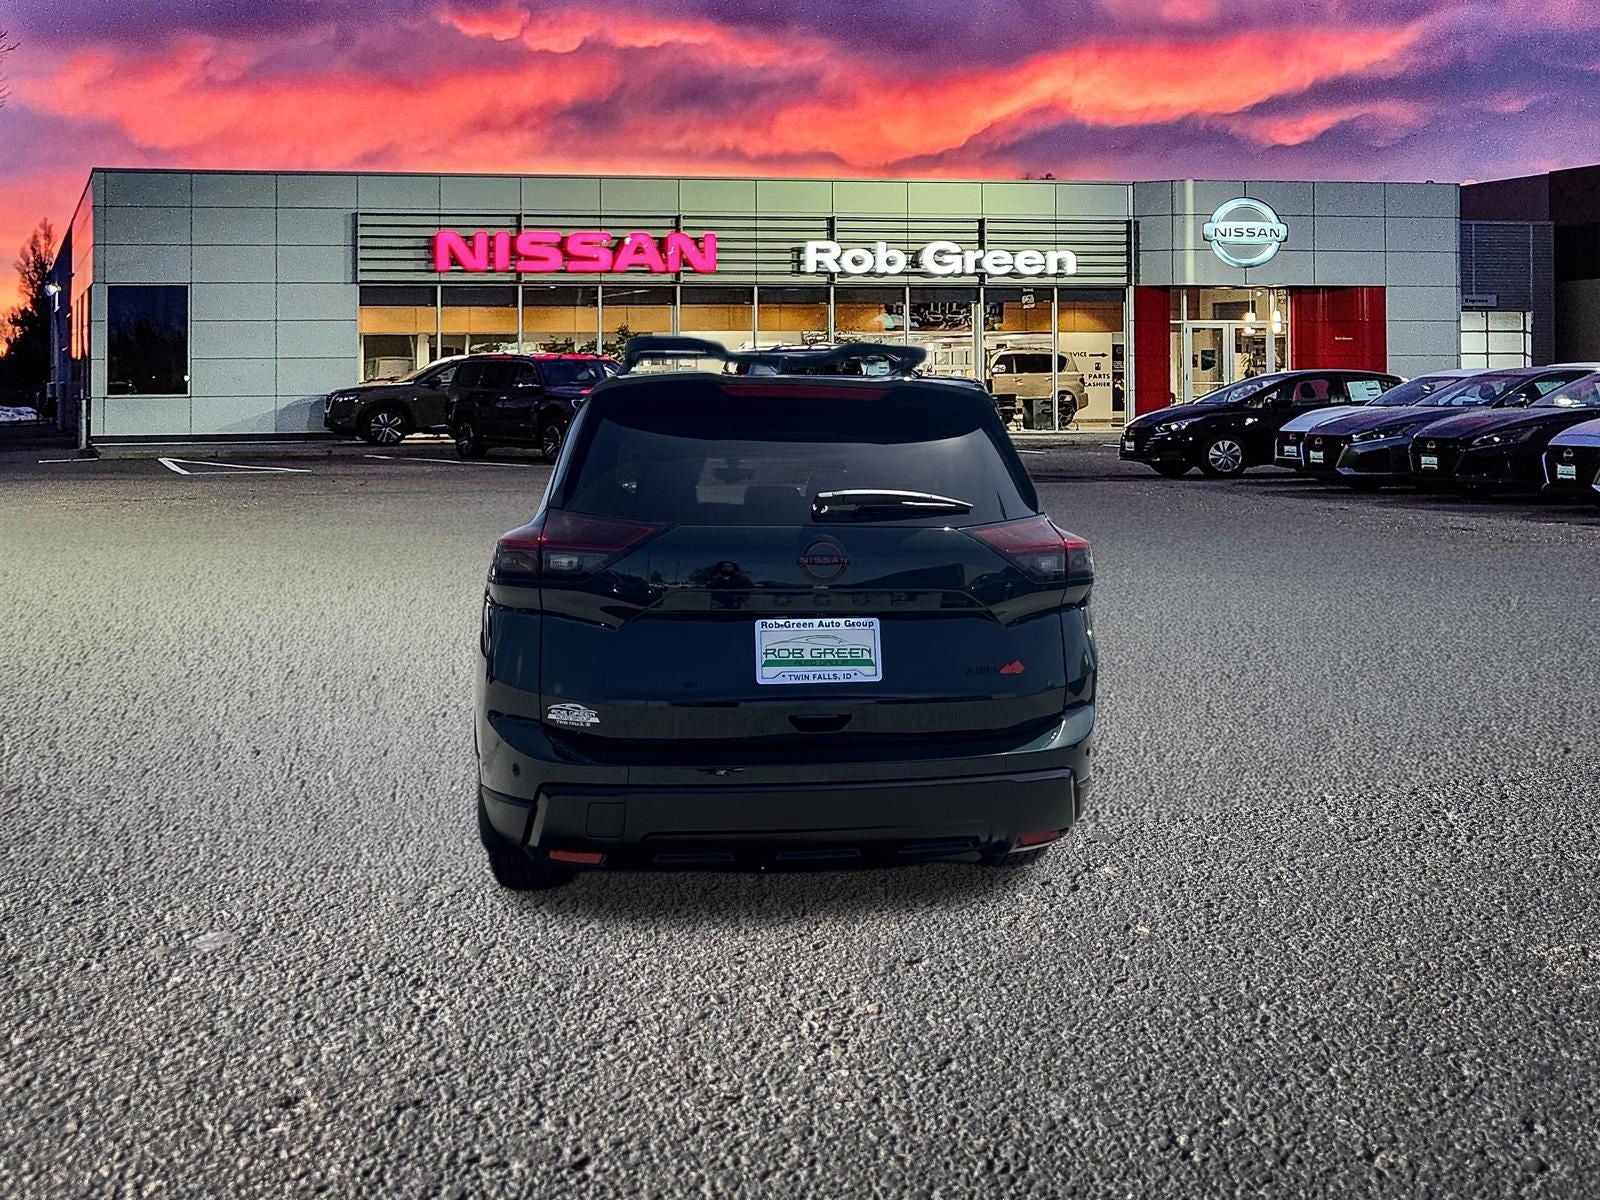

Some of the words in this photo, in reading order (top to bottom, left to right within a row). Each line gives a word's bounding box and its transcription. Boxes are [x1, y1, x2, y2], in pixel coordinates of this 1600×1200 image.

[1214, 228, 1280, 238] NISSAN
[434, 231, 718, 273] NISSAN
[805, 240, 907, 275] Rob
[922, 240, 1078, 275] Green
[800, 556, 848, 564] NISSAN
[818, 620, 840, 628] Auto
[844, 620, 874, 628] Group
[763, 648, 804, 659] ROB
[810, 647, 872, 658] GREEN
[813, 673, 840, 681] FALLS,
